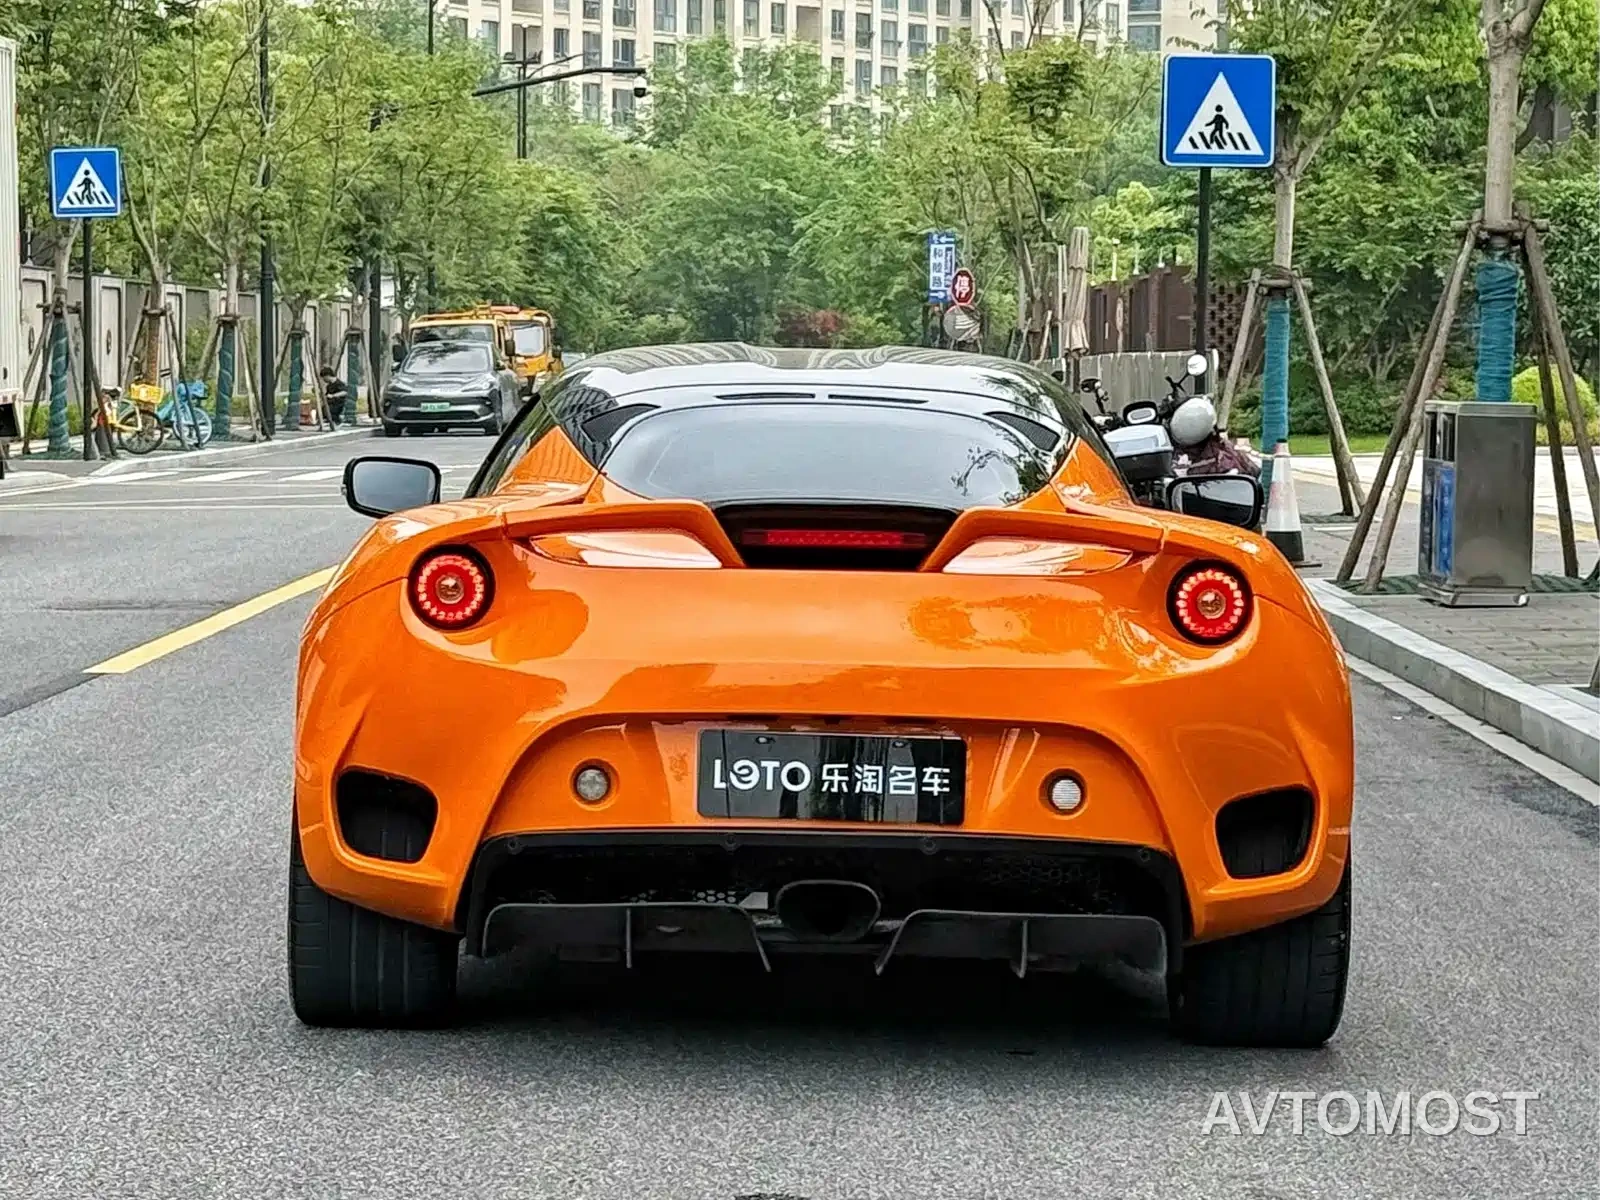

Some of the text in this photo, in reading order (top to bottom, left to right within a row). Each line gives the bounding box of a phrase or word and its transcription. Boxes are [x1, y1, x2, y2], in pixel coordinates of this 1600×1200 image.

[955, 274, 971, 299] 停
[713, 758, 950, 796] LOTO 乐淘名车
